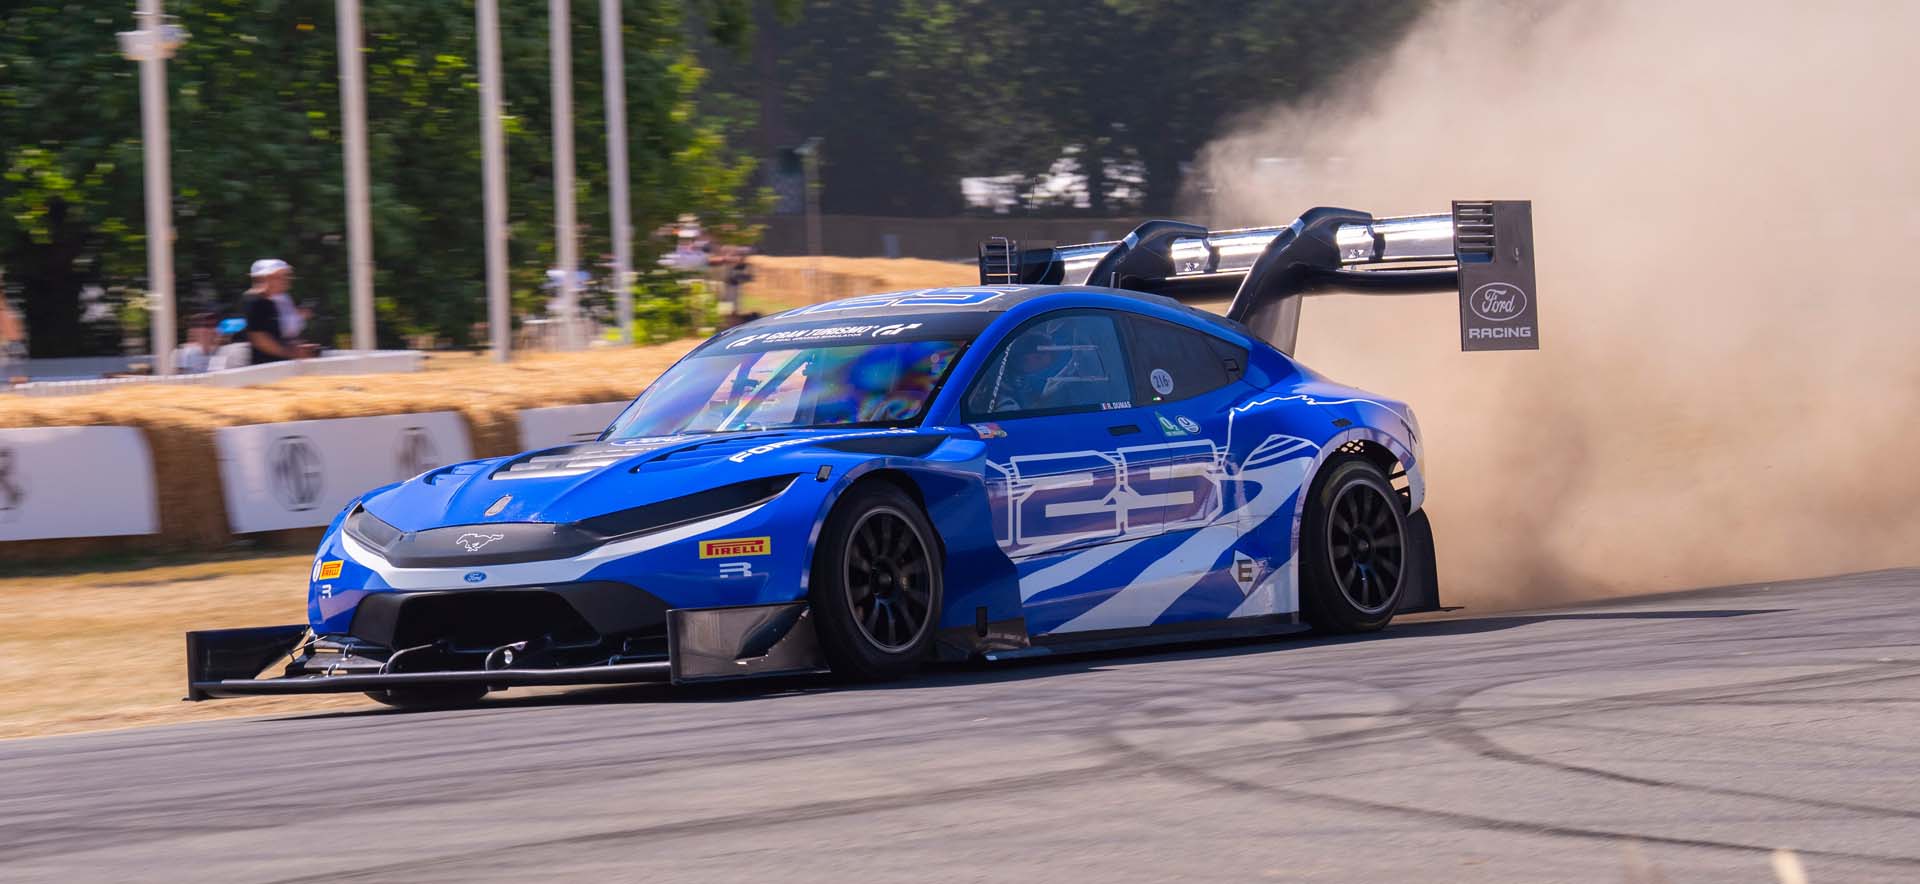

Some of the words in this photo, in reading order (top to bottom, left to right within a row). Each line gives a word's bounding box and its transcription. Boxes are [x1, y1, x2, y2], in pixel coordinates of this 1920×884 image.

[1482, 289, 1515, 313] Ford
[1469, 327, 1531, 339] RACING
[706, 539, 765, 556] PIRELLI
[1236, 558, 1253, 582] E
